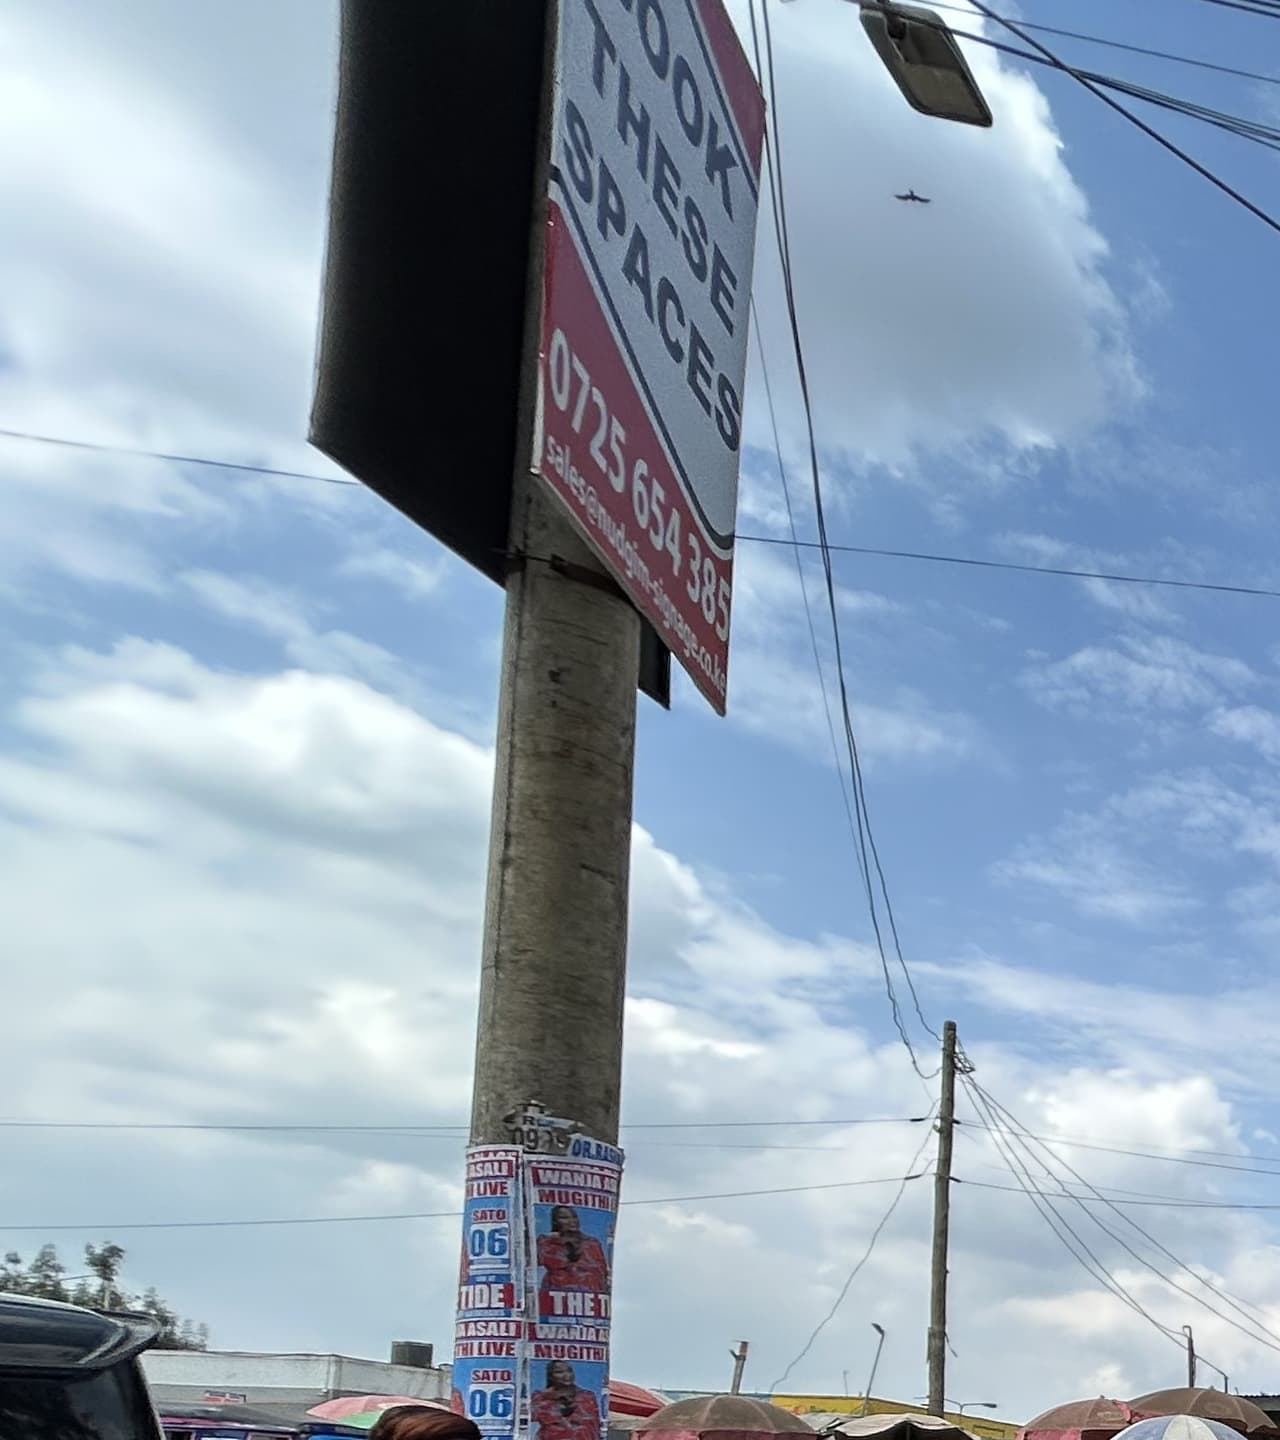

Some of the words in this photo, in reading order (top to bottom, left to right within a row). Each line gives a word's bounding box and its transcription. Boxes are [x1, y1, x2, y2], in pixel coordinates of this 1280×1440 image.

[622, 0, 738, 223] OOK
[583, 0, 737, 338] THESE
[563, 98, 740, 452] SPACES
[549, 327, 626, 493] 0725
[632, 458, 682, 577] 654
[686, 535, 731, 643] 385
[467, 1161, 509, 1178] ASALI
[474, 1181, 508, 1196] LIVE
[537, 1188, 611, 1211] MUGITHI
[472, 1208, 507, 1222] SATO
[471, 1228, 509, 1257] 06
[459, 1284, 505, 1310] TIDE
[549, 1292, 595, 1316] THE
[478, 1342, 516, 1357] LIVE
[472, 1369, 512, 1382] SATO
[470, 1388, 512, 1418] 06
